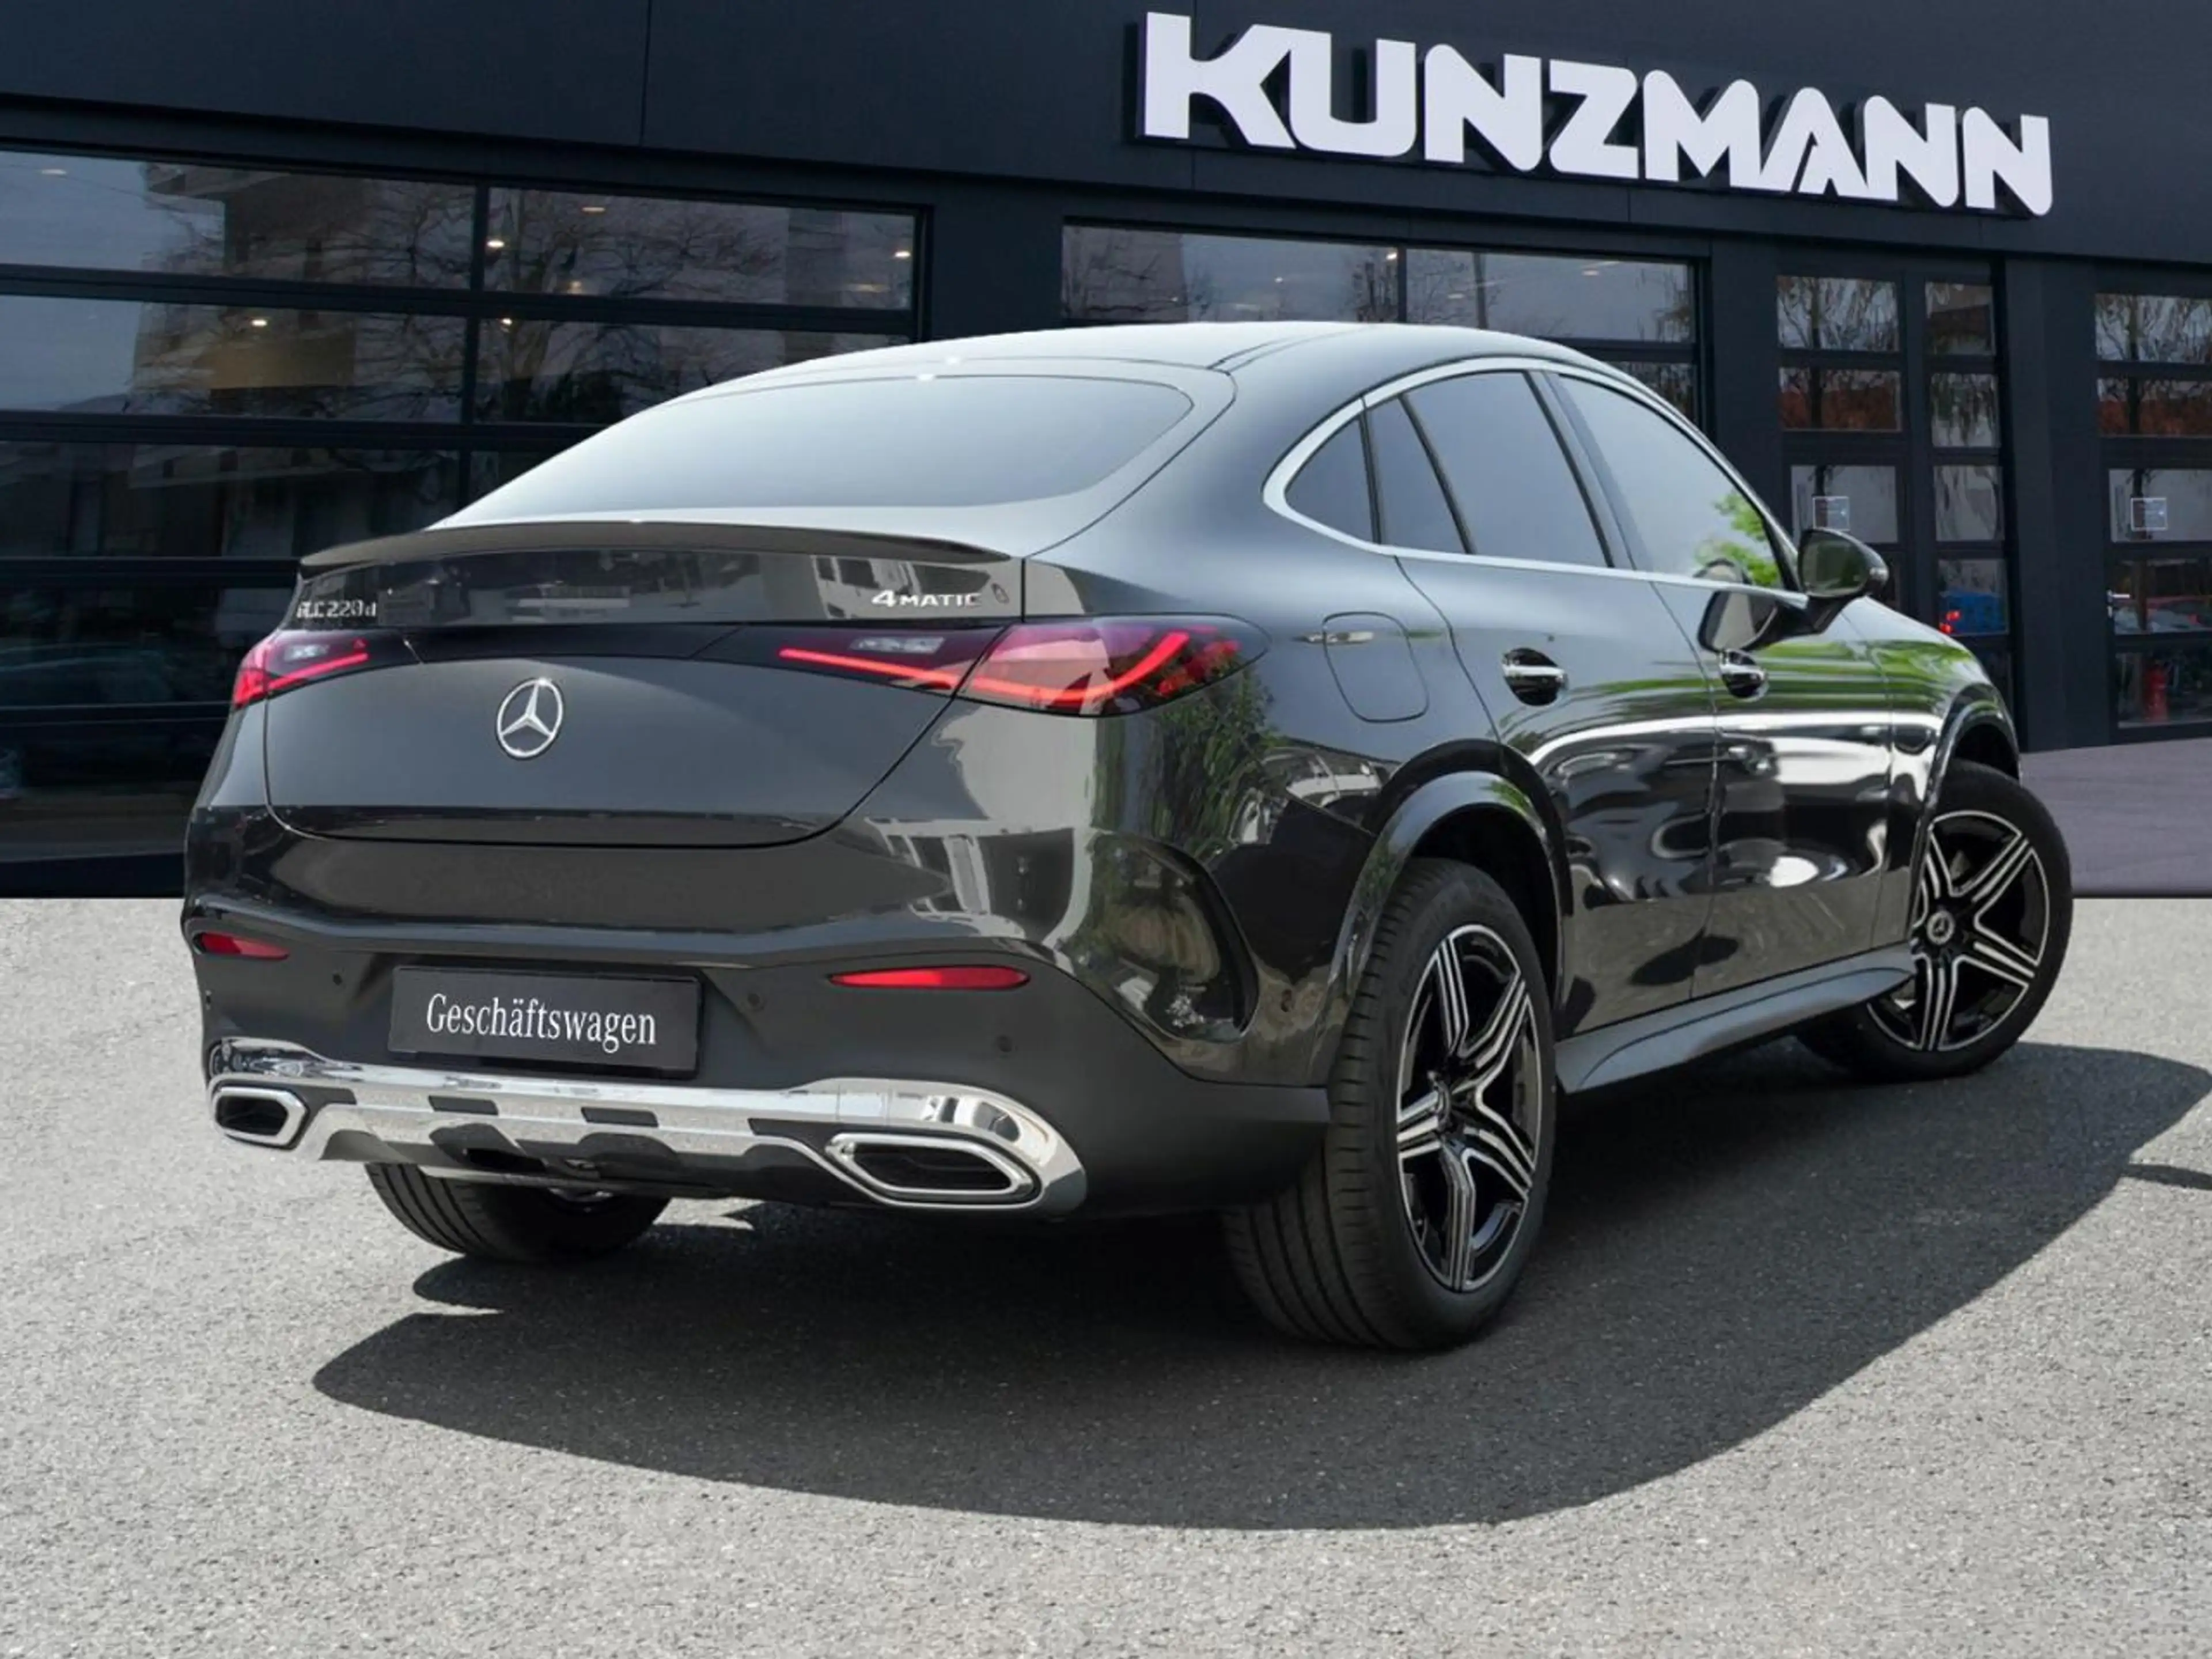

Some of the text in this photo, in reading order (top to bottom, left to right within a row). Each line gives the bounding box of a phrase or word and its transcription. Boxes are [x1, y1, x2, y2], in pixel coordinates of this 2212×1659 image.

[1143, 12, 2051, 215] KUNZMANN
[872, 589, 981, 607] 4MATIC
[427, 994, 656, 1054] Geschäftswagen
